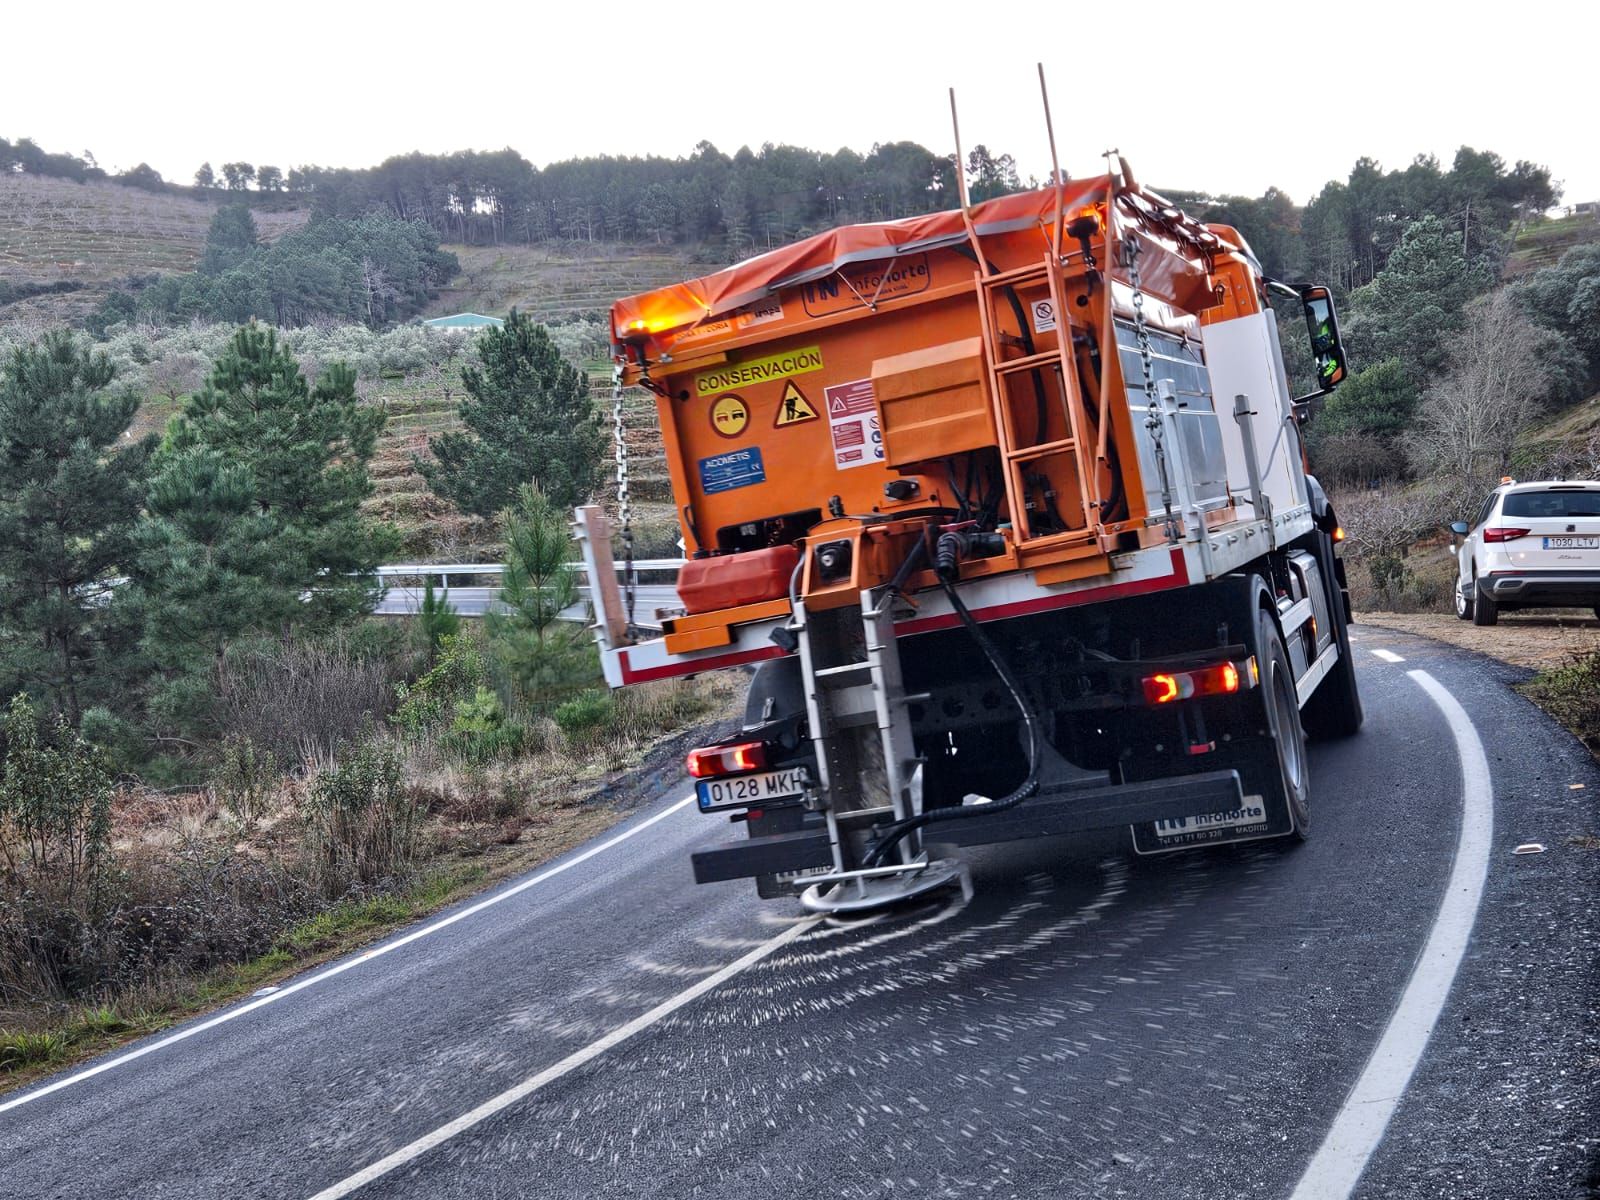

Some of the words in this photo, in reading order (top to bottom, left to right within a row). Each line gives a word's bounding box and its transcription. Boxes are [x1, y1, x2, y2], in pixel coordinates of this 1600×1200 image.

[698, 351, 821, 391] CONSERVACIÓN
[1551, 538, 1573, 546] 1030
[711, 778, 759, 802] 0128
[765, 772, 802, 795] MKH
